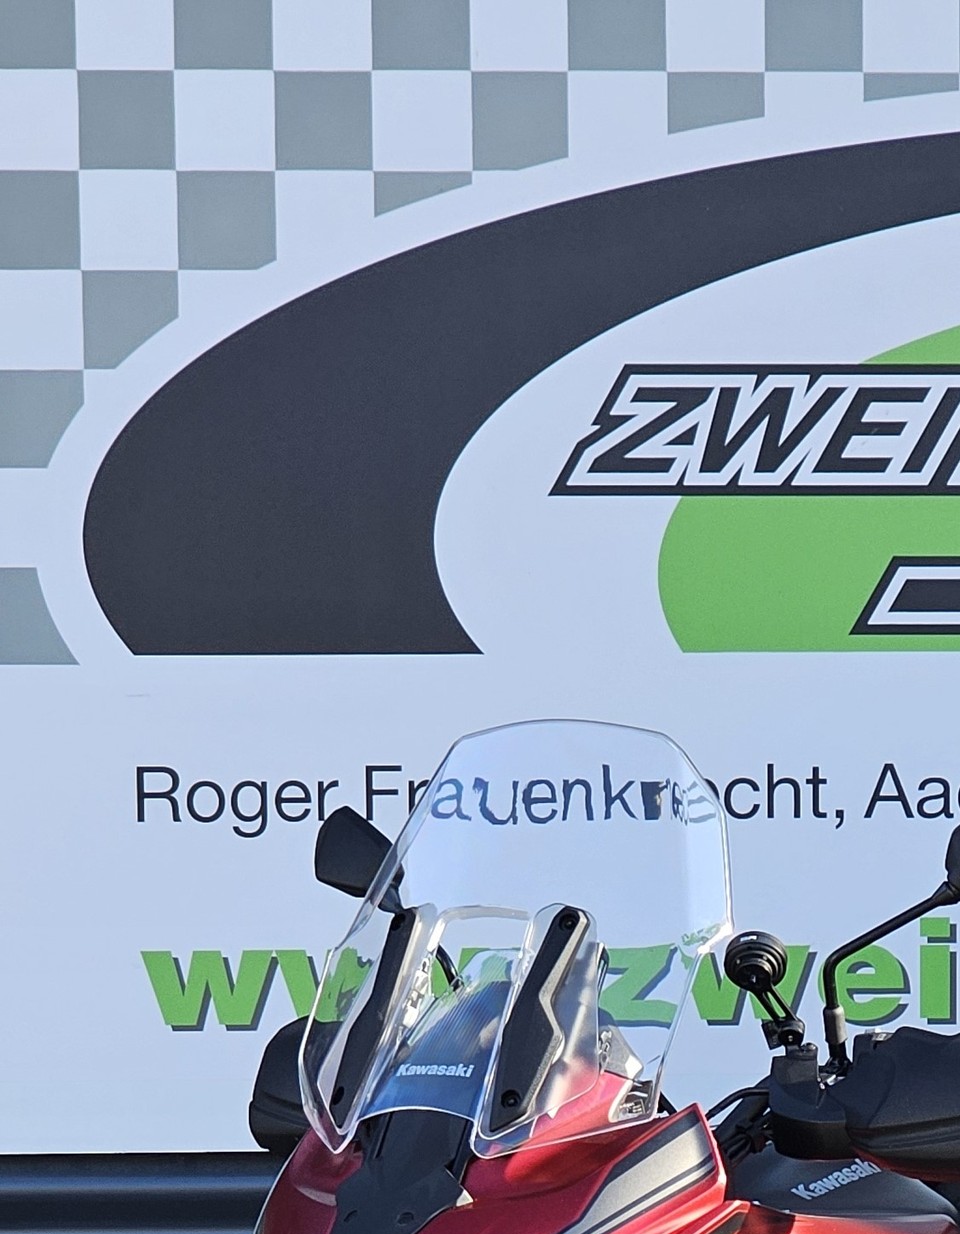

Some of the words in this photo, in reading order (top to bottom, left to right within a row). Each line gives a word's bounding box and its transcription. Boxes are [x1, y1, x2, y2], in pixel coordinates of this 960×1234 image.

[136, 765, 340, 839] Roger
[396, 1062, 475, 1078] Kawasaki
[790, 1158, 882, 1200] Kawasaki
